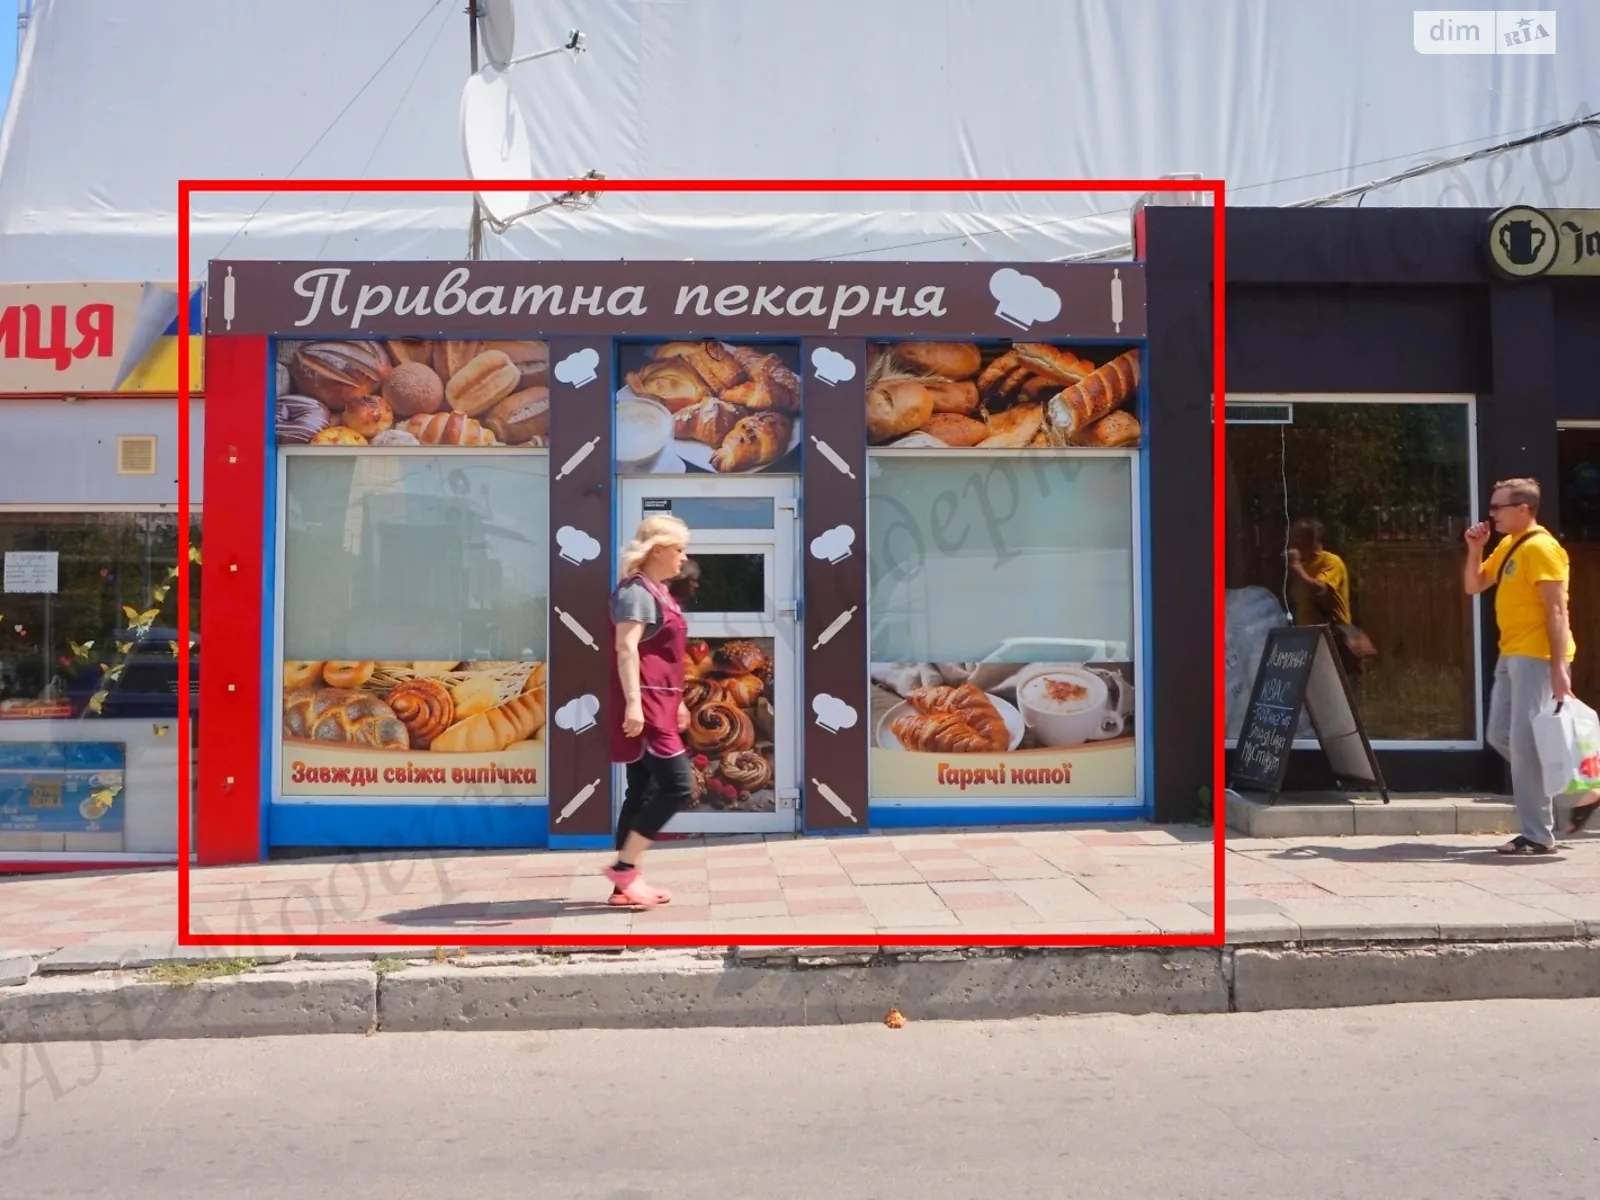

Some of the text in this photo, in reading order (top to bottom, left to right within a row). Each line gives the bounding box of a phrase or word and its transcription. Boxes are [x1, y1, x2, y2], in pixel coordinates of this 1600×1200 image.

[293, 267, 948, 330] Приватна пекарня
[291, 760, 537, 787] Завжди свіжа випічка
[937, 762, 1073, 790] Гарячі напої
